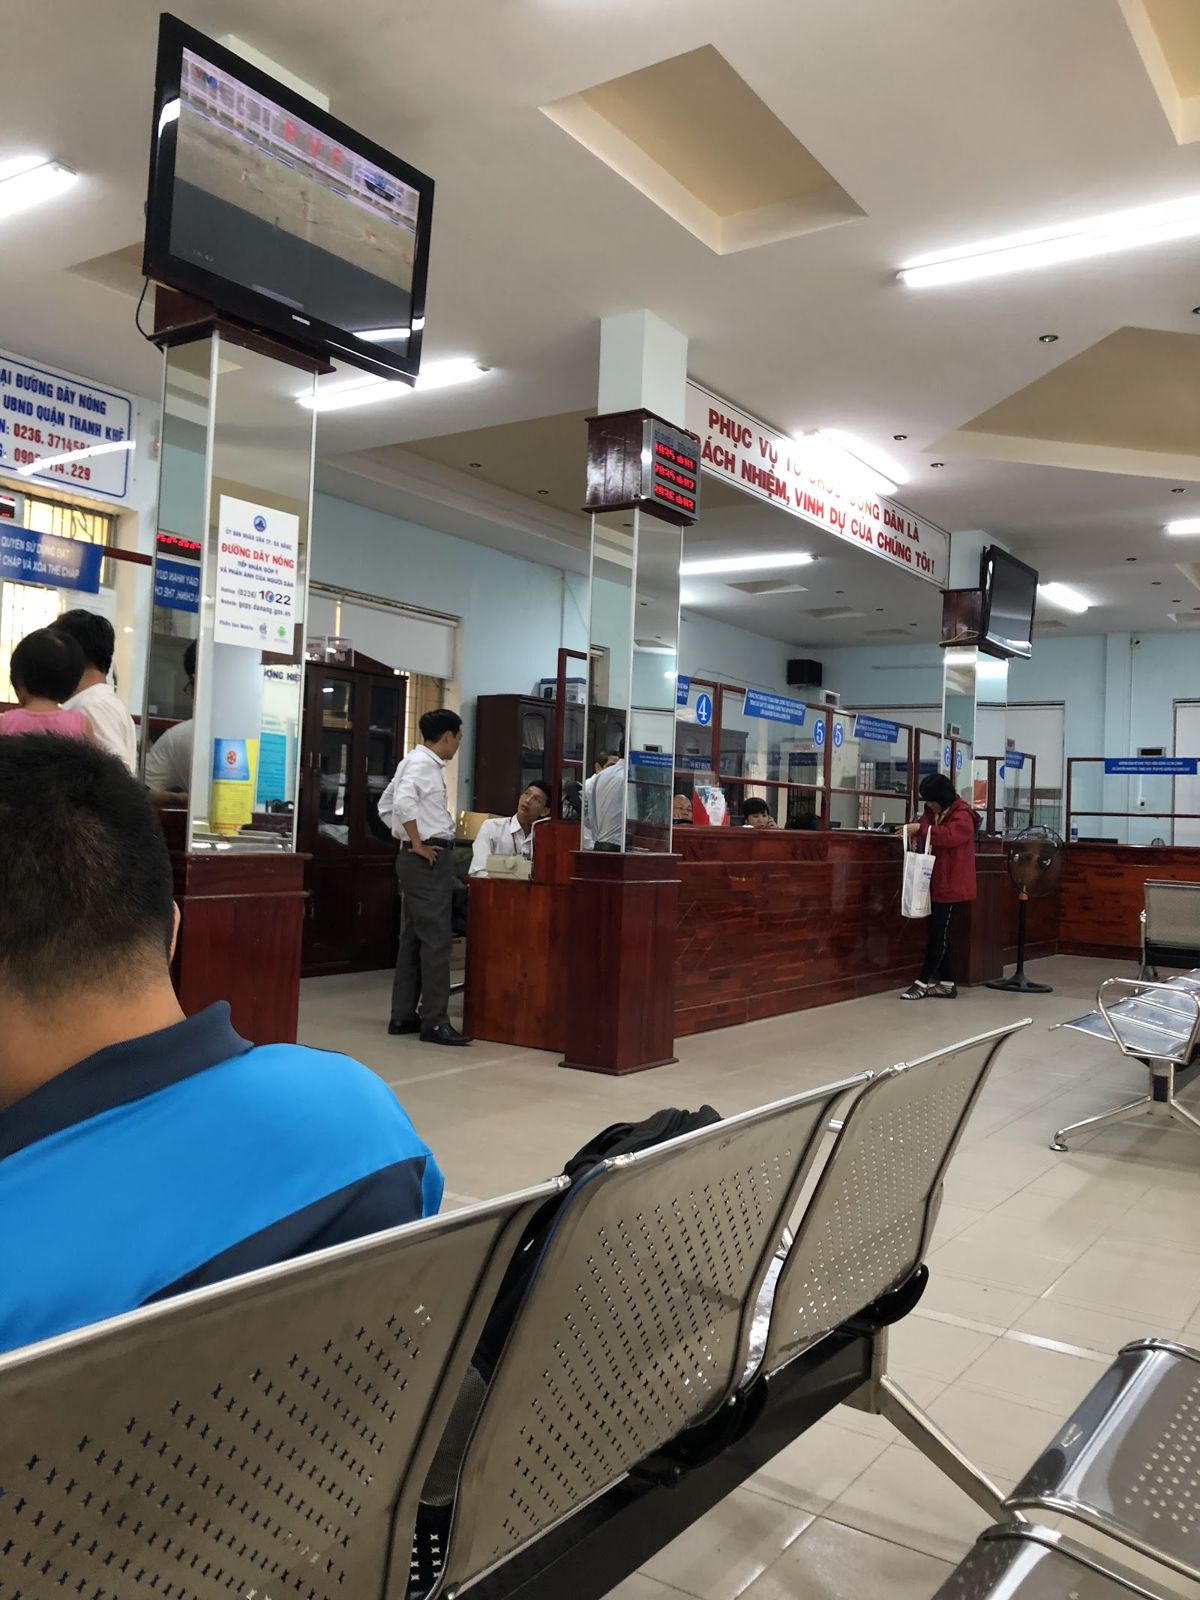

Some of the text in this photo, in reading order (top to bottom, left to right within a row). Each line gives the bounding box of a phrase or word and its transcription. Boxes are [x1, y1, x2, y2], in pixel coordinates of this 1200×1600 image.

[3, 394, 33, 416] UBND
[37, 405, 65, 427] QUẬN
[69, 415, 102, 438] THANH
[79, 394, 107, 416] NÓNG
[708, 407, 753, 449] PHỤC
[758, 436, 778, 469] VỤ
[883, 508, 904, 535] DÂN
[907, 521, 920, 543] LÀ
[685, 428, 736, 474] ÁCH
[741, 459, 790, 505] NHIỆM,
[795, 487, 824, 519] VINH
[829, 506, 847, 535] DỰ
[851, 516, 873, 545] CỦA
[877, 531, 912, 563] CHÚNG
[221, 542, 295, 569] ĐƯỜNG DÂY NÓNG
[697, 696, 708, 721] 4
[816, 722, 823, 743] 5
[835, 724, 842, 746] 5
